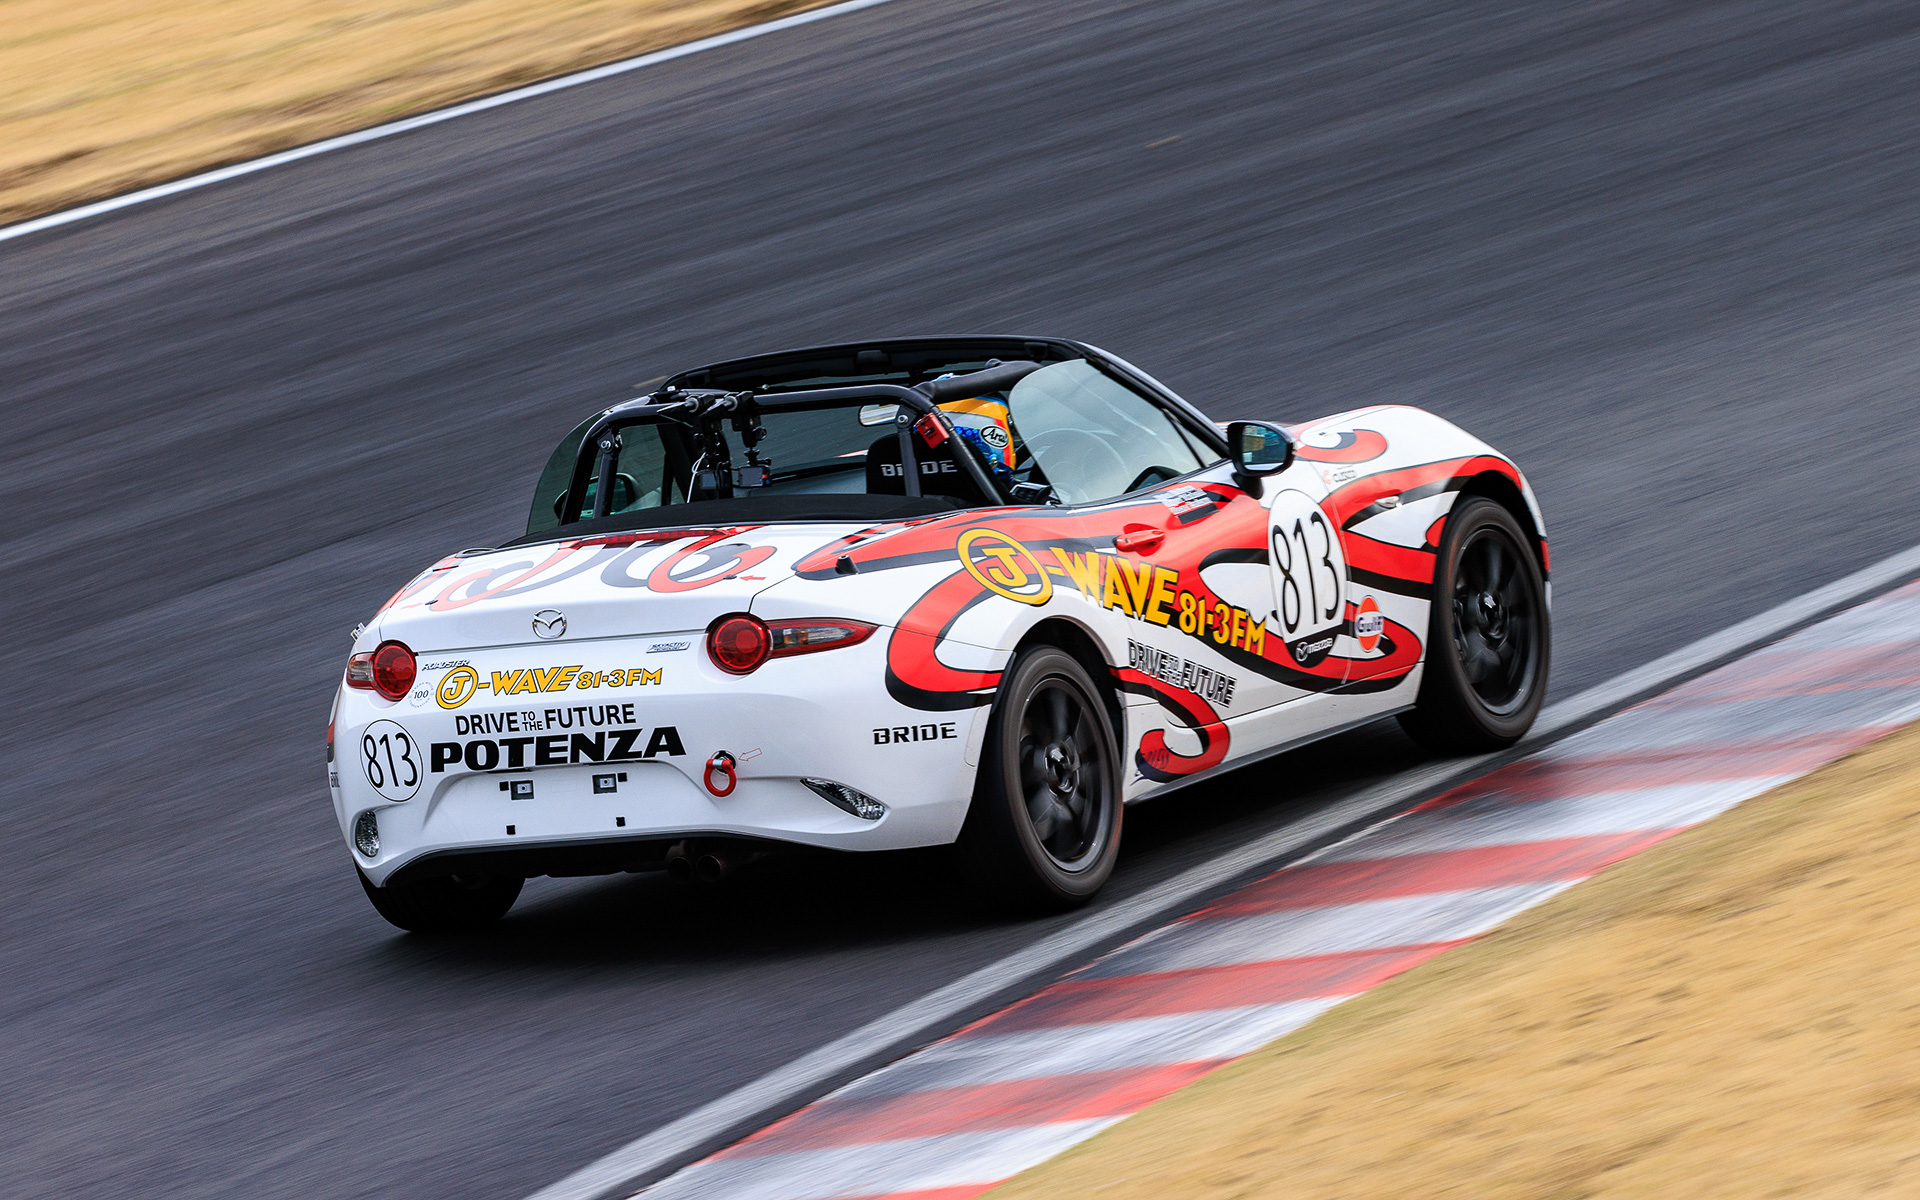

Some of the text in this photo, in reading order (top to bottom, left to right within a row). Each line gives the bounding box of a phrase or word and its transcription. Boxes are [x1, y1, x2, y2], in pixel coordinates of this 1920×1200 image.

[957, 527, 1179, 628] J-WAVE
[1272, 511, 1339, 634] 813
[1355, 616, 1384, 633] Gulf
[414, 690, 429, 699] 100
[435, 665, 583, 710] J-WAVE
[1127, 638, 1170, 684] DRIVE
[1181, 659, 1238, 709] FUTURE
[455, 703, 636, 736] DRIVE TO THE FUTURE
[872, 722, 958, 745] BRIDE
[363, 732, 418, 789] 813
[430, 726, 687, 774] POTENZA
